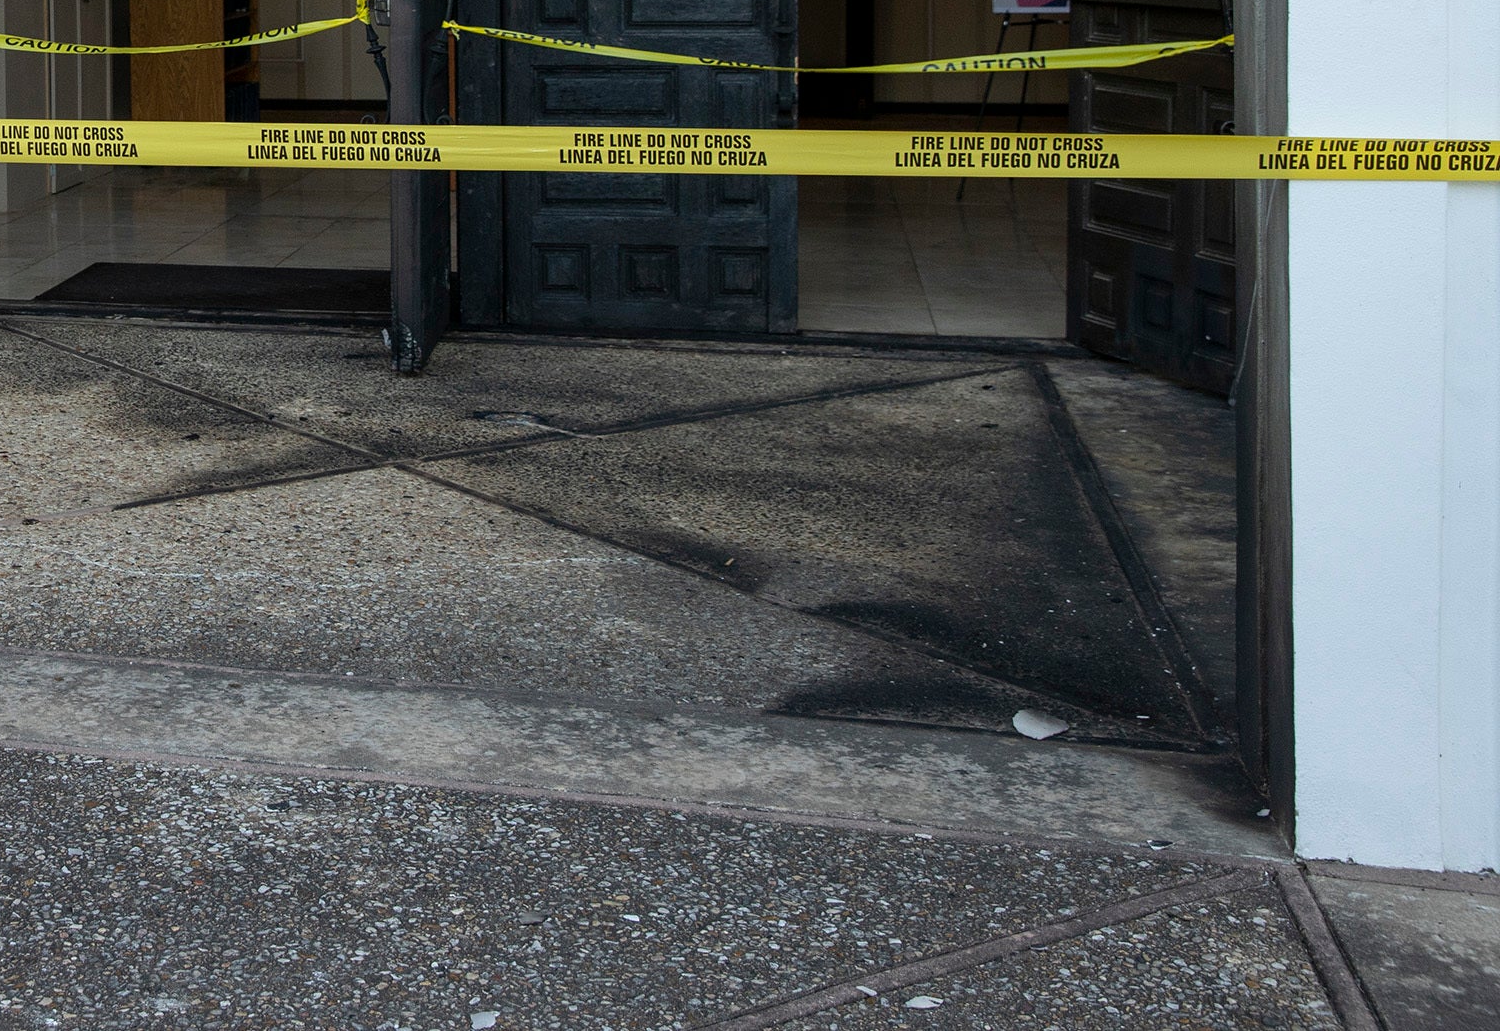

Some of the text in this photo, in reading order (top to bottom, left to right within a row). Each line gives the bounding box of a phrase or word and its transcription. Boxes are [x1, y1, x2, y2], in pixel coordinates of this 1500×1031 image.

[5, 37, 107, 53] CAUTION
[2, 125, 29, 139] LINE
[34, 126, 50, 139] DO
[54, 127, 79, 140] NOT
[83, 127, 124, 141] CROSS
[261, 129, 425, 145] FIRE LINE DO NOT CROSS
[574, 133, 751, 149] FIRE LINE DO NOT CROSS
[0, 141, 23, 155] DEL
[28, 142, 67, 156] FUEGO
[72, 143, 91, 156] NO
[95, 143, 138, 157] CRUZA
[911, 137, 1103, 151] FIRE LINE DO NOT CROSS
[1277, 140, 1491, 152] FIRE LINE DO NOT CROSS
[248, 145, 441, 162] LINEA DEL FUEGO NO CRUZA
[560, 149, 767, 166] LINEA DEL FUEGO NO CRUZA
[896, 153, 1119, 169] LINEA DEL FUEGO NO CRUZA
[1259, 154, 1309, 169] LINEA
[1316, 154, 1347, 169] DEL
[1354, 154, 1409, 170] FUEGO
[1416, 155, 1441, 170] NO
